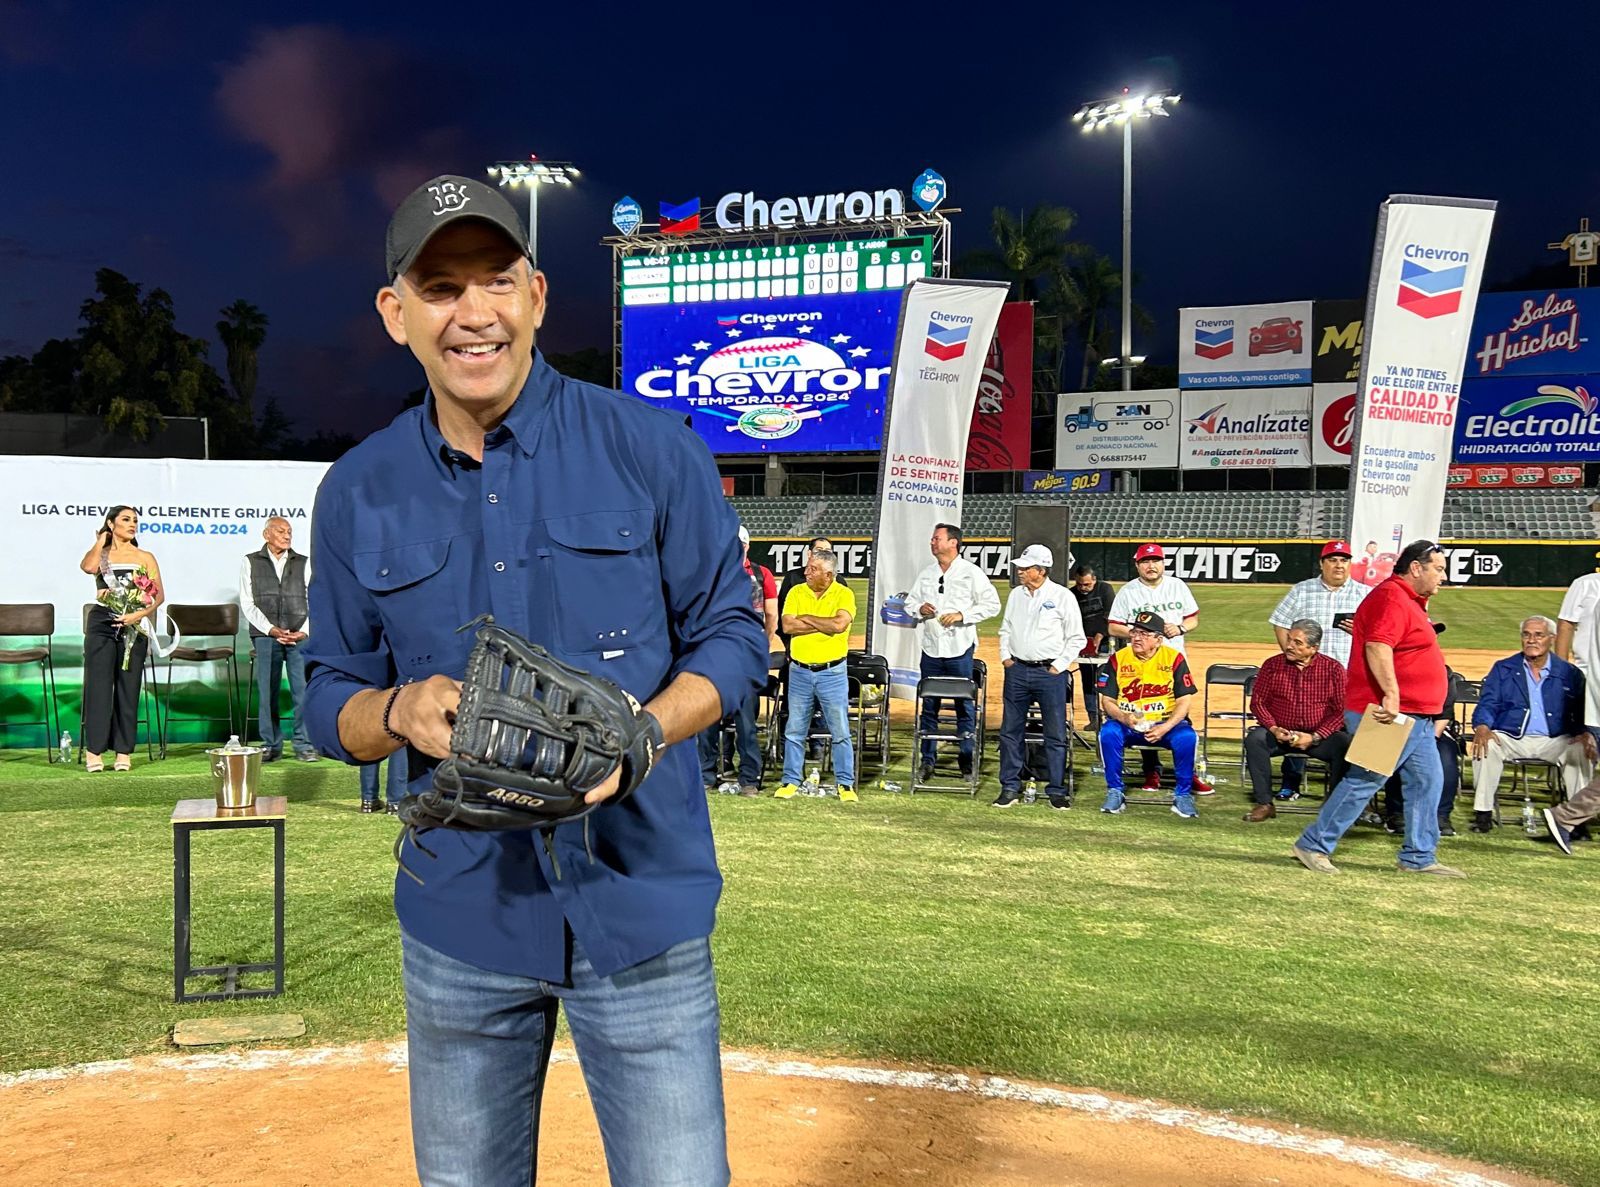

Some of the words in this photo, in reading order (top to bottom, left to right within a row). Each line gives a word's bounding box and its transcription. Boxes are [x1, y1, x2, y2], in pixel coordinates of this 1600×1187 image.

[716, 188, 902, 232] Chevron
[871, 253, 881, 264] B
[891, 251, 900, 263] S
[911, 250, 922, 261] O
[1404, 244, 1469, 263] Chevron
[740, 311, 822, 324] Chevron
[930, 310, 973, 324] Chevron
[1509, 293, 1575, 331] Salsa
[1195, 319, 1234, 328] Chevron
[1477, 313, 1578, 372] Huichol
[739, 354, 801, 369] LIGA
[919, 369, 959, 384] TECHRON
[1188, 376, 1201, 384] Vas
[1219, 375, 1240, 383] todo,
[1269, 373, 1302, 382] contigo.
[1386, 365, 1398, 376] YA
[1401, 366, 1414, 377] NO
[1416, 368, 1447, 381] TIENES
[1372, 376, 1390, 387] QUE
[1393, 378, 1425, 390] ELEGIR
[1427, 381, 1458, 394] ENTRE
[687, 394, 800, 406] TEMPORADA
[803, 392, 849, 403] 2024
[1370, 388, 1438, 410] CALIDAD
[1445, 395, 1457, 412] Y
[1216, 413, 1309, 434] Analízate
[1368, 405, 1453, 427] RENDIMIENTO
[1465, 413, 1600, 438] Electrolit
[1364, 445, 1405, 457] Encuentra
[1408, 450, 1436, 461] ambos
[1459, 441, 1552, 454] ¡HIDRATACIÓN
[1555, 442, 1600, 452] TOTAL!
[892, 454, 905, 463] LA
[1363, 459, 1373, 467] en
[1375, 458, 1383, 467] la
[1385, 460, 1418, 471] gasolina
[891, 467, 907, 477] DE
[910, 468, 959, 484] SENTIRTE
[1071, 473, 1100, 490] 90.9
[1362, 468, 1394, 480] Chevron
[1396, 474, 1410, 482] con
[889, 480, 958, 496] ACOMPAÑADO
[1361, 480, 1410, 497] TECHRON
[888, 492, 903, 501] EN
[906, 494, 934, 505] CADA
[935, 498, 957, 508] RUTA
[22, 504, 58, 516] LIGA
[65, 505, 143, 517] CHEVN
[148, 506, 230, 518] CLEMENTE
[236, 507, 307, 519] GRIJALVA
[140, 523, 205, 535] PORADA
[211, 524, 247, 535] 2024
[1257, 555, 1279, 569] 18+
[1476, 556, 1500, 572] 18+
